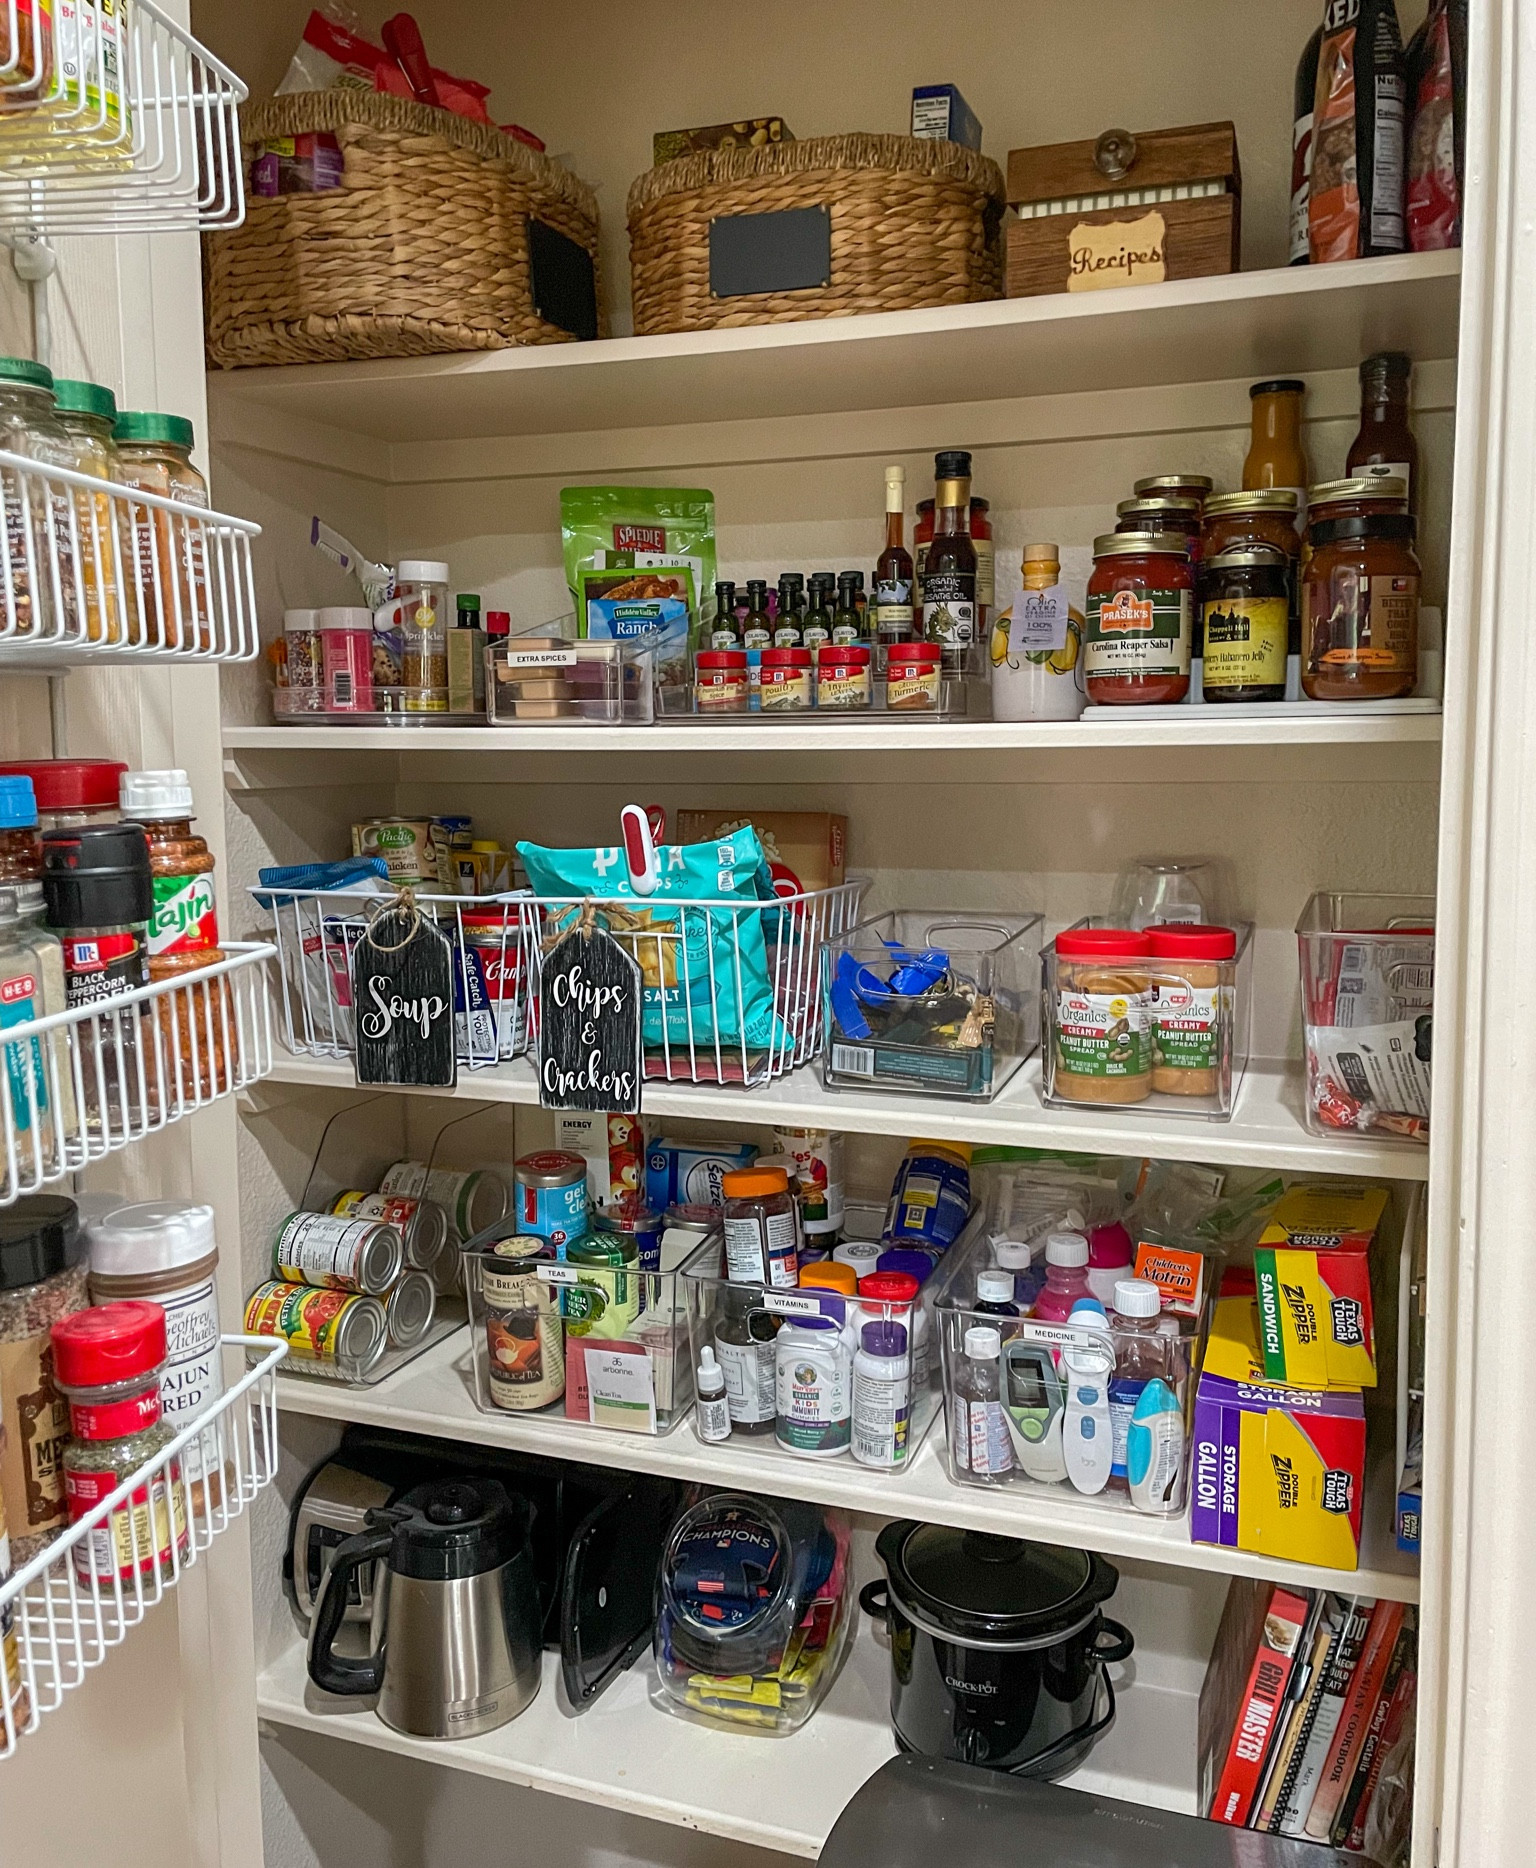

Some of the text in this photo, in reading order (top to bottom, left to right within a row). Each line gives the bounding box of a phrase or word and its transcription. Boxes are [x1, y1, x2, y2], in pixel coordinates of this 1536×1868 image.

[1072, 246, 1161, 276] Recipes
[619, 526, 661, 548] SPIEDIE
[953, 592, 967, 600] OIL
[1103, 609, 1149, 621] PRASEK'S
[616, 621, 657, 635] Ranch
[1092, 640, 1169, 652] Carolina Reaper Salsa
[894, 684, 930, 697] Turmeric
[382, 829, 413, 843] Pacific
[388, 861, 419, 871] hicken
[617, 879, 672, 893] CPS
[72, 971, 105, 988] BLACK
[464, 953, 483, 1009] Safe Catch
[552, 965, 628, 1019] Chips
[643, 989, 680, 1002] SALT
[362, 975, 449, 1039] Soup
[1062, 1004, 1107, 1025] Organics
[473, 1014, 484, 1037] YOU
[581, 1023, 597, 1045] &
[1068, 1026, 1097, 1037] CREAMY
[1158, 1030, 1212, 1042] PEANUT BUTTER
[1169, 1021, 1201, 1030] CREAMY
[1060, 1034, 1110, 1049] PEANUT BUTTER
[1070, 1046, 1095, 1054] SPREAD
[1170, 1040, 1199, 1048] SPREAD
[543, 1049, 635, 1101] Crackers
[562, 1120, 592, 1129] ENERGY
[564, 1184, 585, 1204] get
[707, 1162, 721, 1207] Seltze
[568, 1200, 587, 1215] cle
[553, 1232, 564, 1240] 36
[547, 1270, 566, 1278] TEAS
[1145, 1256, 1192, 1273] Children's
[1140, 1267, 1192, 1288] Motrin
[281, 1294, 296, 1326] PETITE
[773, 1299, 809, 1310] VITAMINS
[1261, 1273, 1280, 1354] SANDWICH
[1280, 1282, 1310, 1345] ZIPPER
[1306, 1303, 1318, 1341] DOUBLE
[1333, 1301, 1349, 1341] TOUGH
[1345, 1303, 1359, 1340] TEXAS
[1034, 1329, 1076, 1342] MEDICINE
[162, 1362, 210, 1392] AJUN
[1237, 1382, 1324, 1397] STORAGE
[1237, 1390, 1322, 1408] GALLON
[163, 1390, 202, 1414] RED
[792, 1406, 820, 1416] IMMUNITY
[795, 1399, 818, 1407] KIDS
[1198, 1441, 1218, 1510] GALLON
[1223, 1445, 1236, 1515] STORAGE
[1270, 1453, 1293, 1510] ZIPPER
[1291, 1474, 1299, 1508] DOUBLE
[1325, 1472, 1338, 1509] TOUGH
[1336, 1475, 1348, 1509] TEXAS
[1403, 1514, 1411, 1537] TEXAS
[1409, 1515, 1418, 1539] TOUGH
[682, 1529, 771, 1549] CHAMPIONS
[1371, 1700, 1390, 1733] Cowboy
[1235, 1697, 1274, 1763] MASTER
[1330, 1713, 1360, 1784] COOKBOOK
[1359, 1734, 1379, 1773] Cocktails
[1223, 1791, 1241, 1822] Walker
